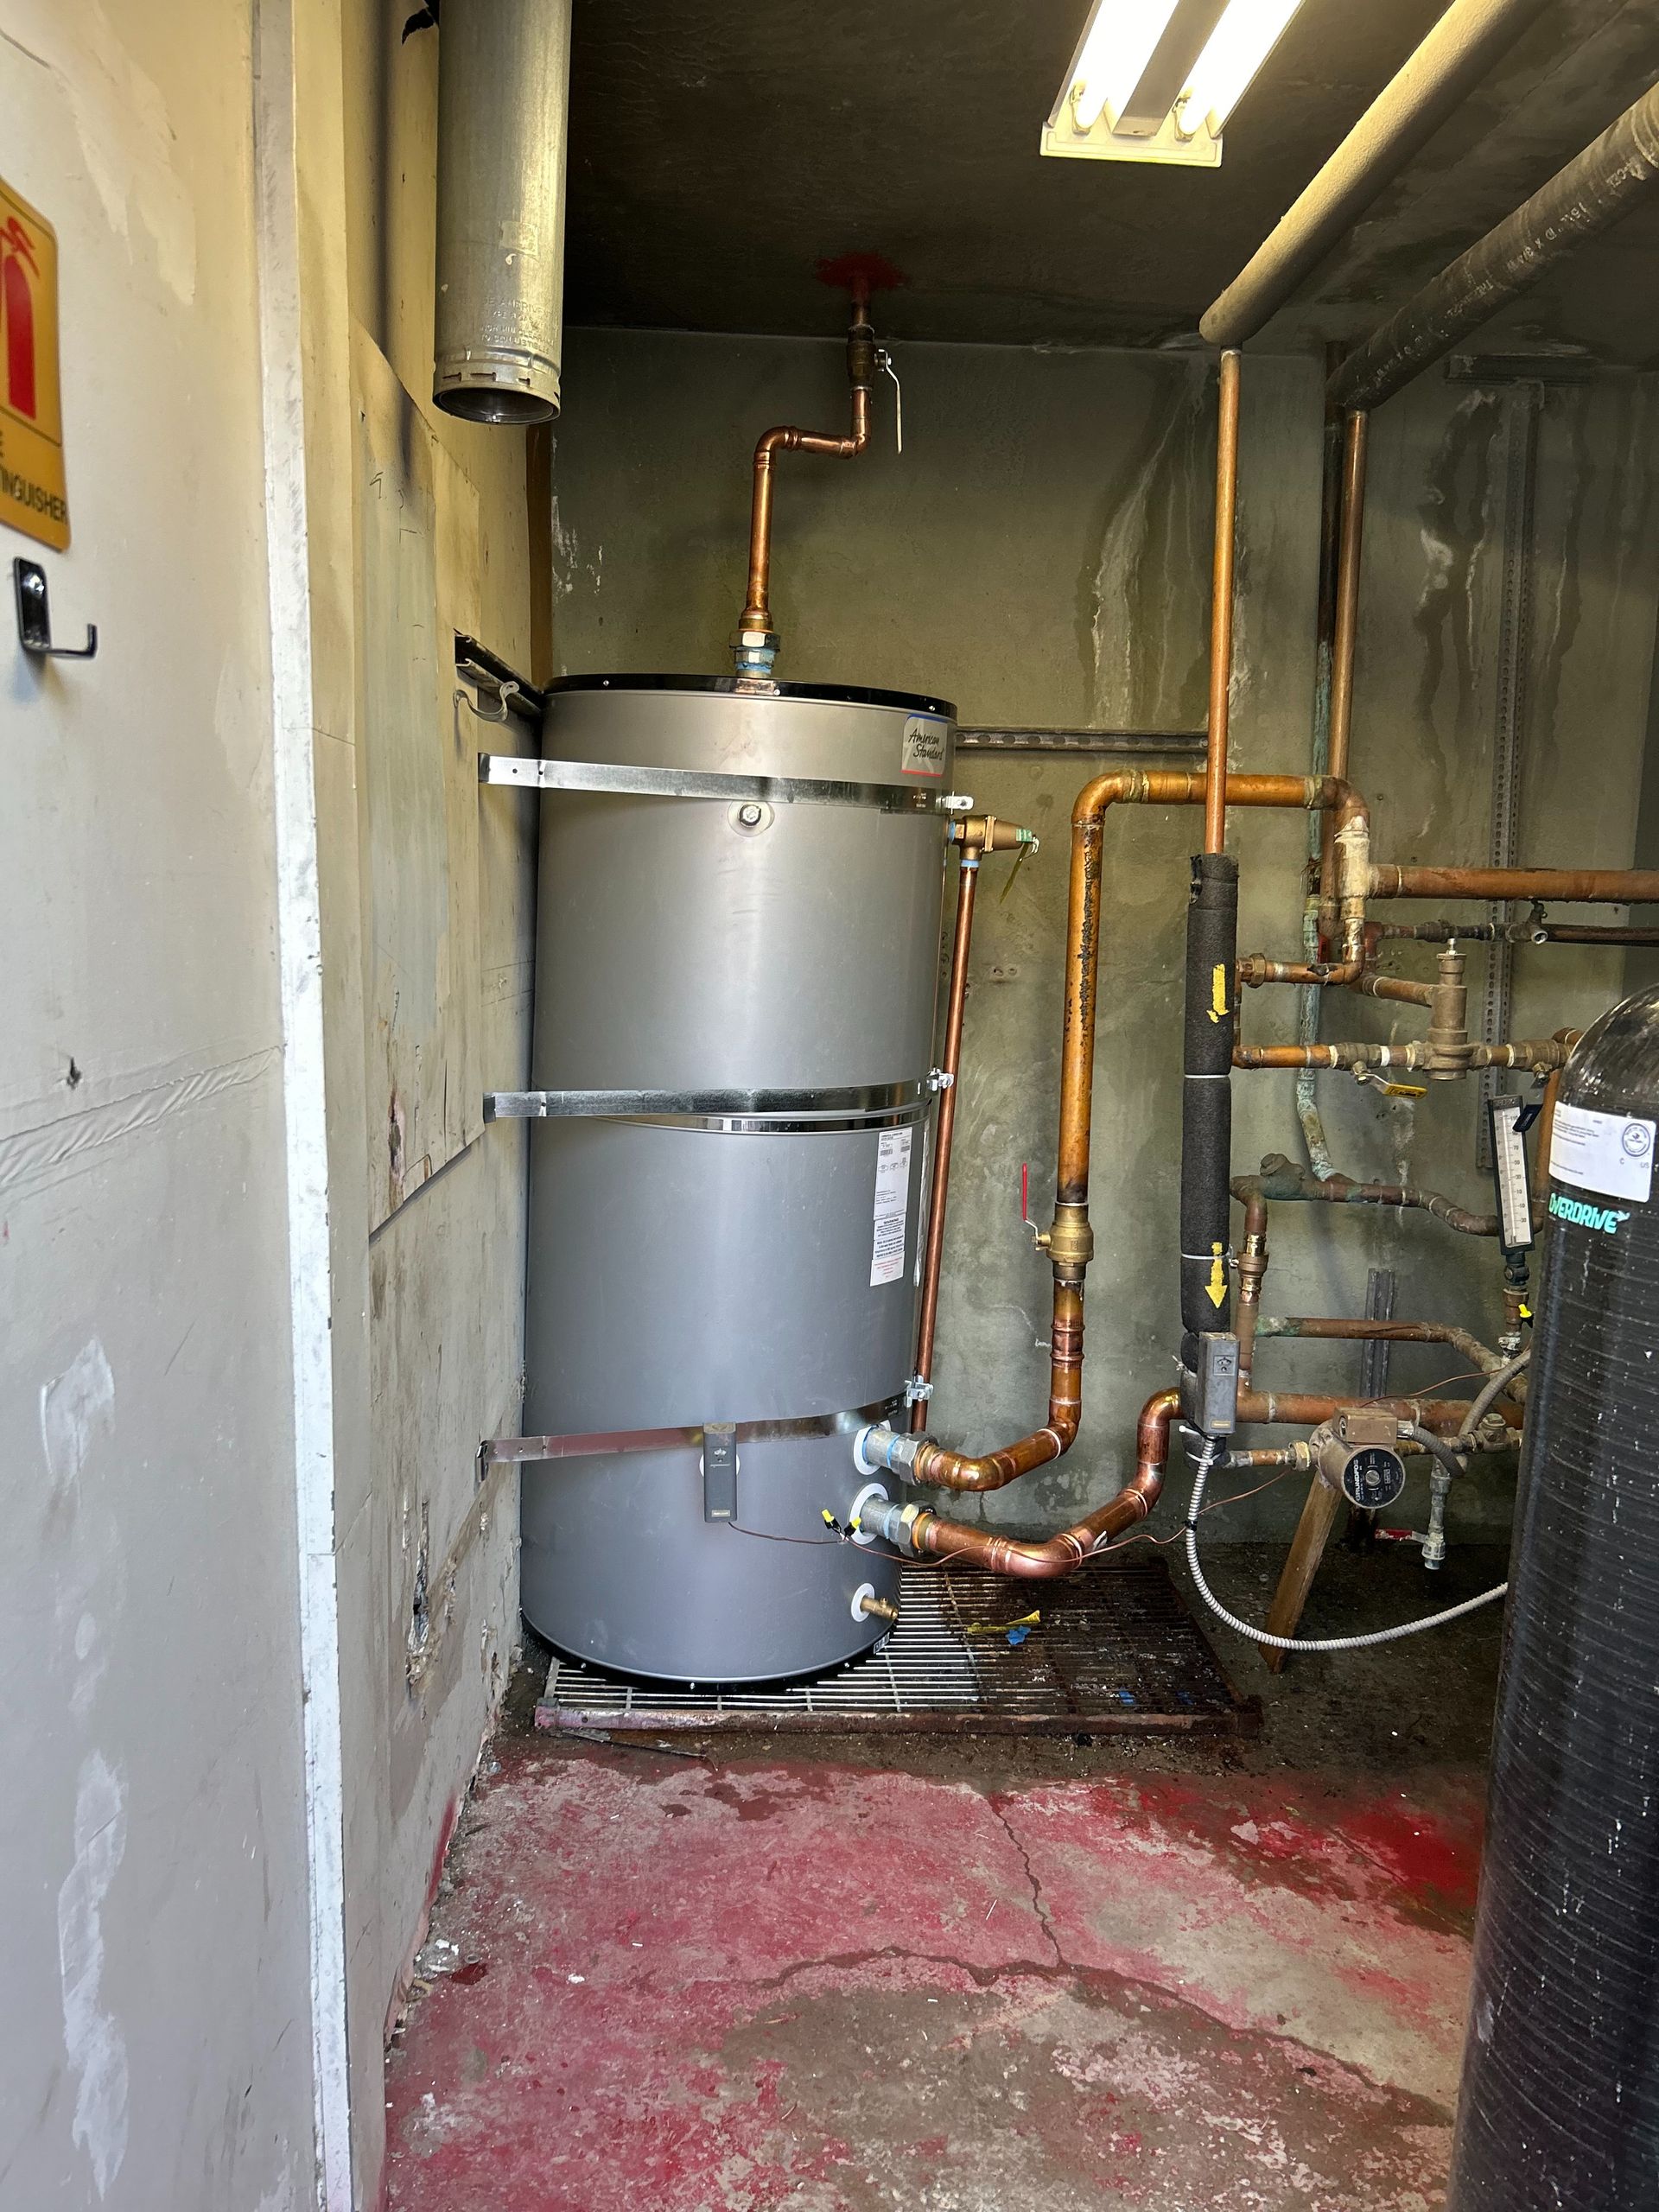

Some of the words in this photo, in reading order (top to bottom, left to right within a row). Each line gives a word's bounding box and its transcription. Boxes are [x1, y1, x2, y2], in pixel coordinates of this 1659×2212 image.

[908, 728, 939, 745] American
[913, 744, 944, 760] Standard
[1548, 1192, 1618, 1234] OVERDRIVE
